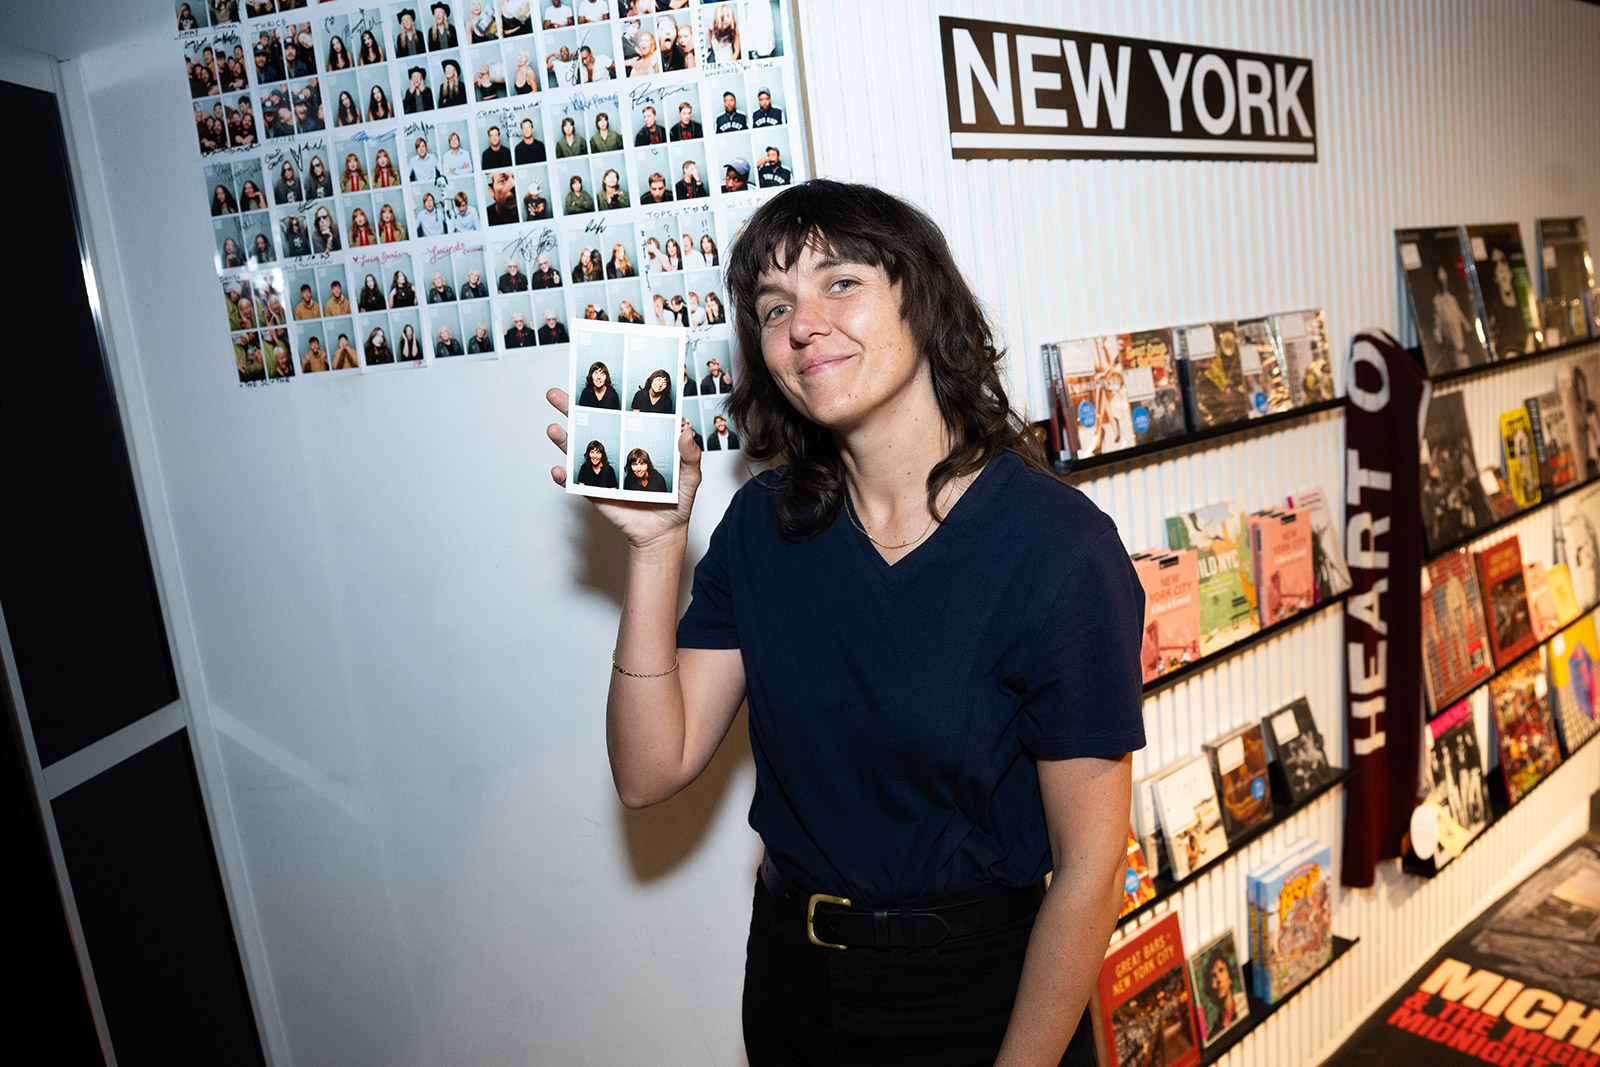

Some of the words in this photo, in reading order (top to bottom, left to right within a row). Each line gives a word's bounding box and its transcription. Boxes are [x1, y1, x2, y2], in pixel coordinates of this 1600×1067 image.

[253, 18, 287, 31] THRICE
[952, 28, 1132, 130] NEW
[1148, 49, 1314, 138] YORK
[646, 210, 673, 219] TOPS
[1346, 328, 1393, 412] O
[1160, 573, 1180, 588] NEW
[1217, 549, 1240, 574] NYC
[1150, 588, 1173, 605] YORK
[1173, 581, 1193, 597] CITY
[1347, 448, 1392, 755] HEART
[1112, 974, 1132, 997] NEW
[1133, 957, 1156, 982] YORK
[1156, 943, 1175, 966] CITY
[1114, 950, 1142, 979] GREAT
[1143, 934, 1166, 959] BARS
[1403, 990, 1432, 1012] &
[1438, 1000, 1500, 1036] THE
